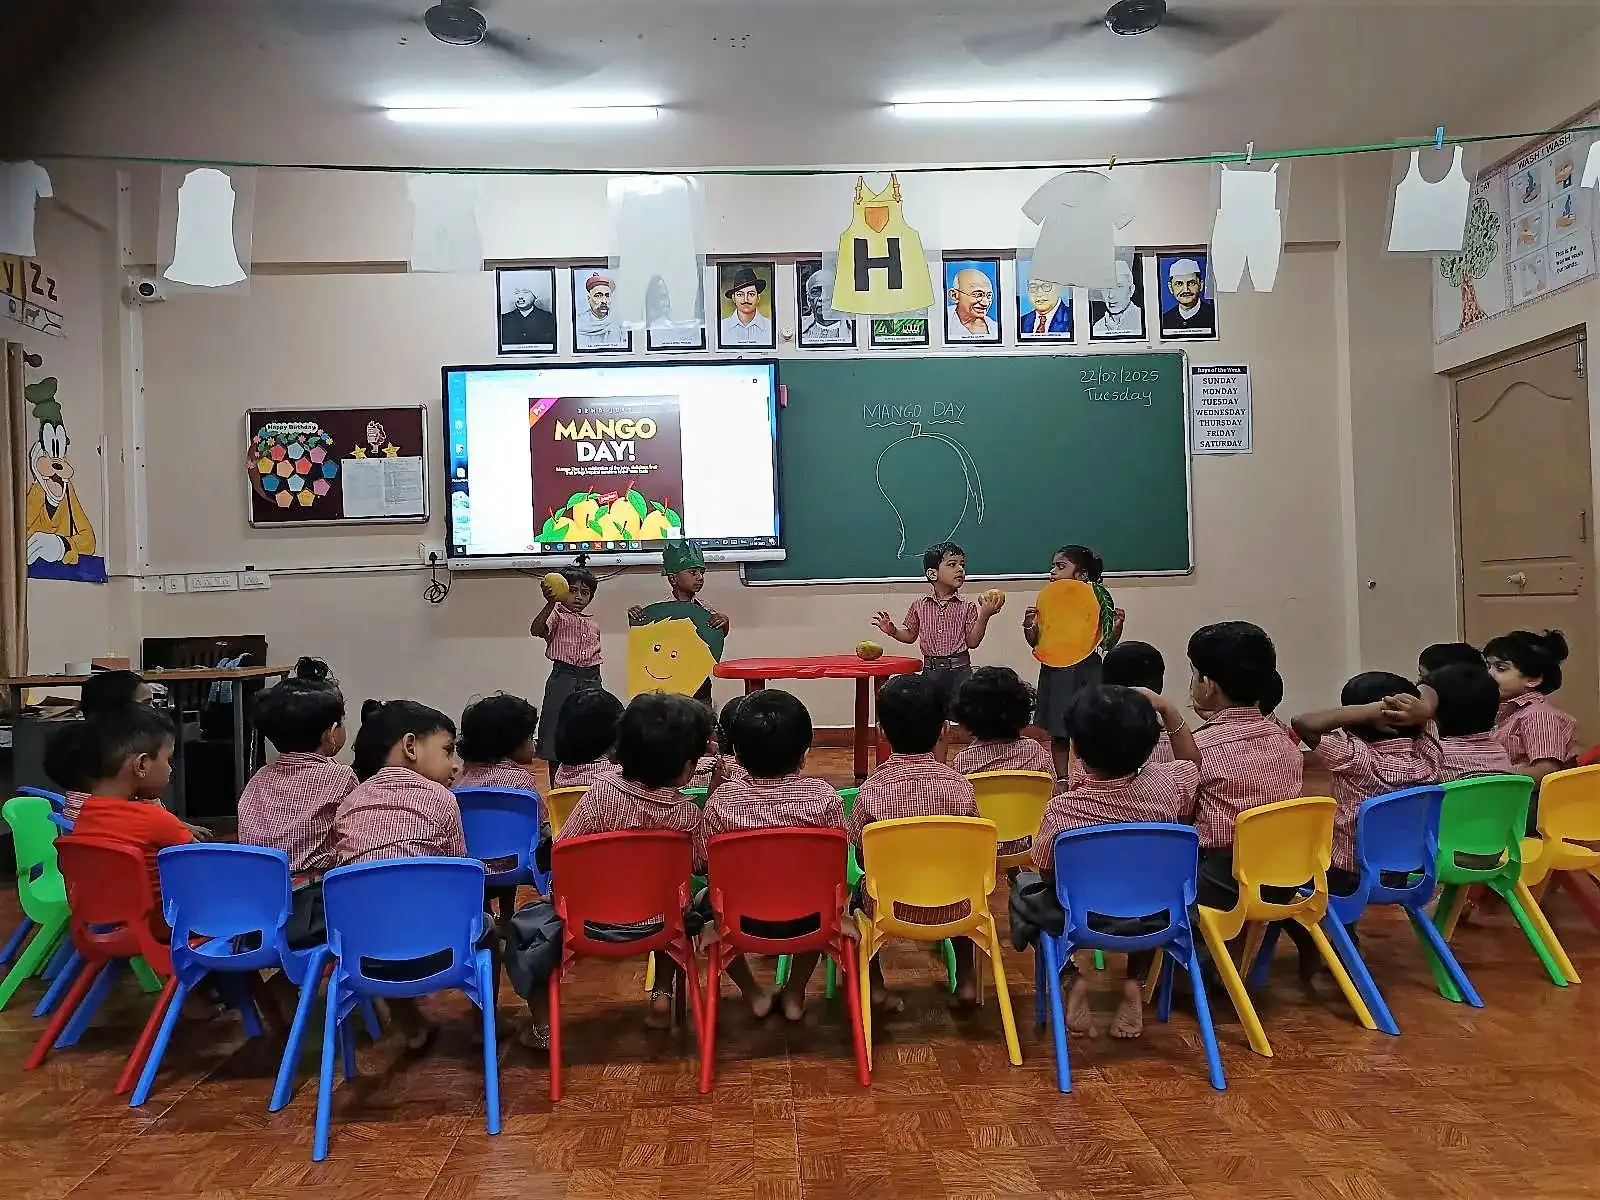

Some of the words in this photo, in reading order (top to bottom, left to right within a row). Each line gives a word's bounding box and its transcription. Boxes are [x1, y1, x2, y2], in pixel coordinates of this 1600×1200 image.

[1517, 151, 1540, 170] WASH
[1546, 133, 1571, 154] WASH
[854, 238, 902, 291] H
[1080, 365, 1159, 385] 22/07/2025
[1202, 377, 1237, 385] SUNDAY
[1083, 387, 1153, 407] Tuesday
[1202, 387, 1238, 395] MONDAY
[1201, 398, 1239, 406] TUESDAY
[863, 403, 922, 420] MANGO
[933, 401, 966, 419] DAY
[1195, 408, 1246, 416] WEDNESDAY
[554, 417, 657, 441] MANGO
[1199, 419, 1242, 427] THURSDAY
[1206, 429, 1236, 437] FRIDAY
[1200, 440, 1243, 448] SATURDAY
[576, 440, 636, 462] DAY!
